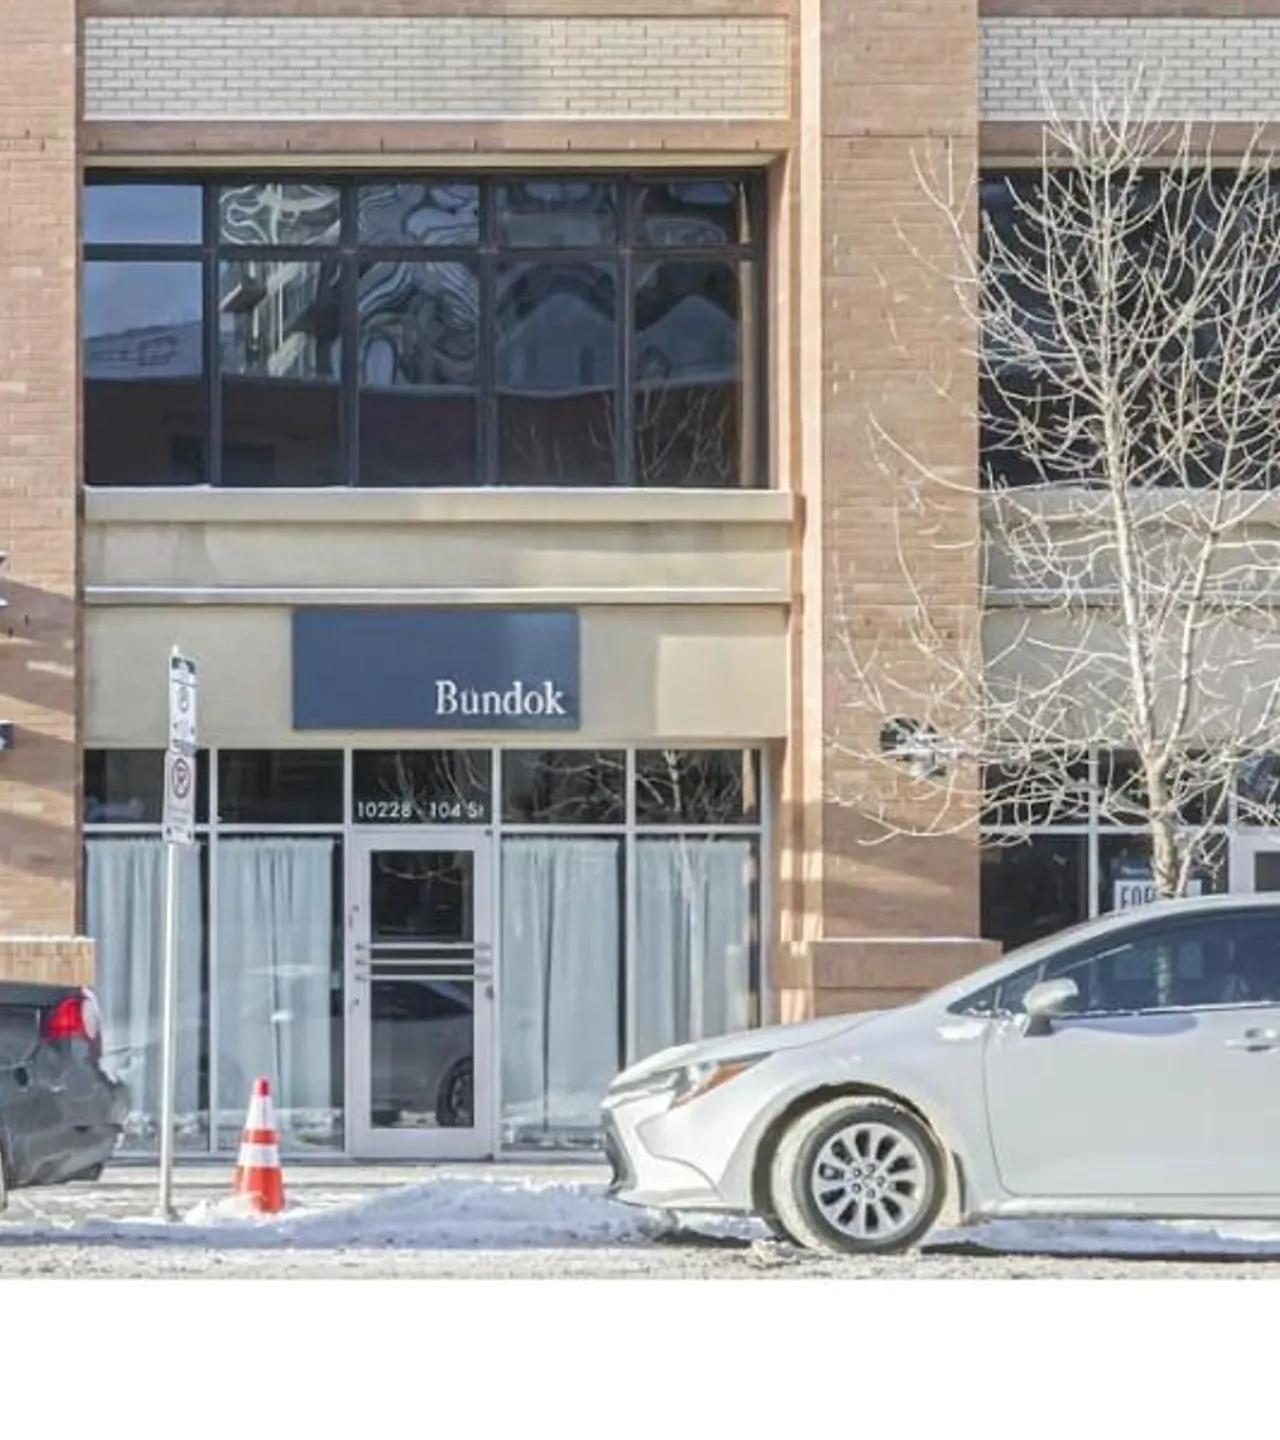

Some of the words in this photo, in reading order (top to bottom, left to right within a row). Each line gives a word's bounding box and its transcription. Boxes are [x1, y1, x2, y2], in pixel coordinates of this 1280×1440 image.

[435, 679, 567, 716] Bundok
[358, 801, 412, 818] 10228
[430, 801, 461, 818] 104
